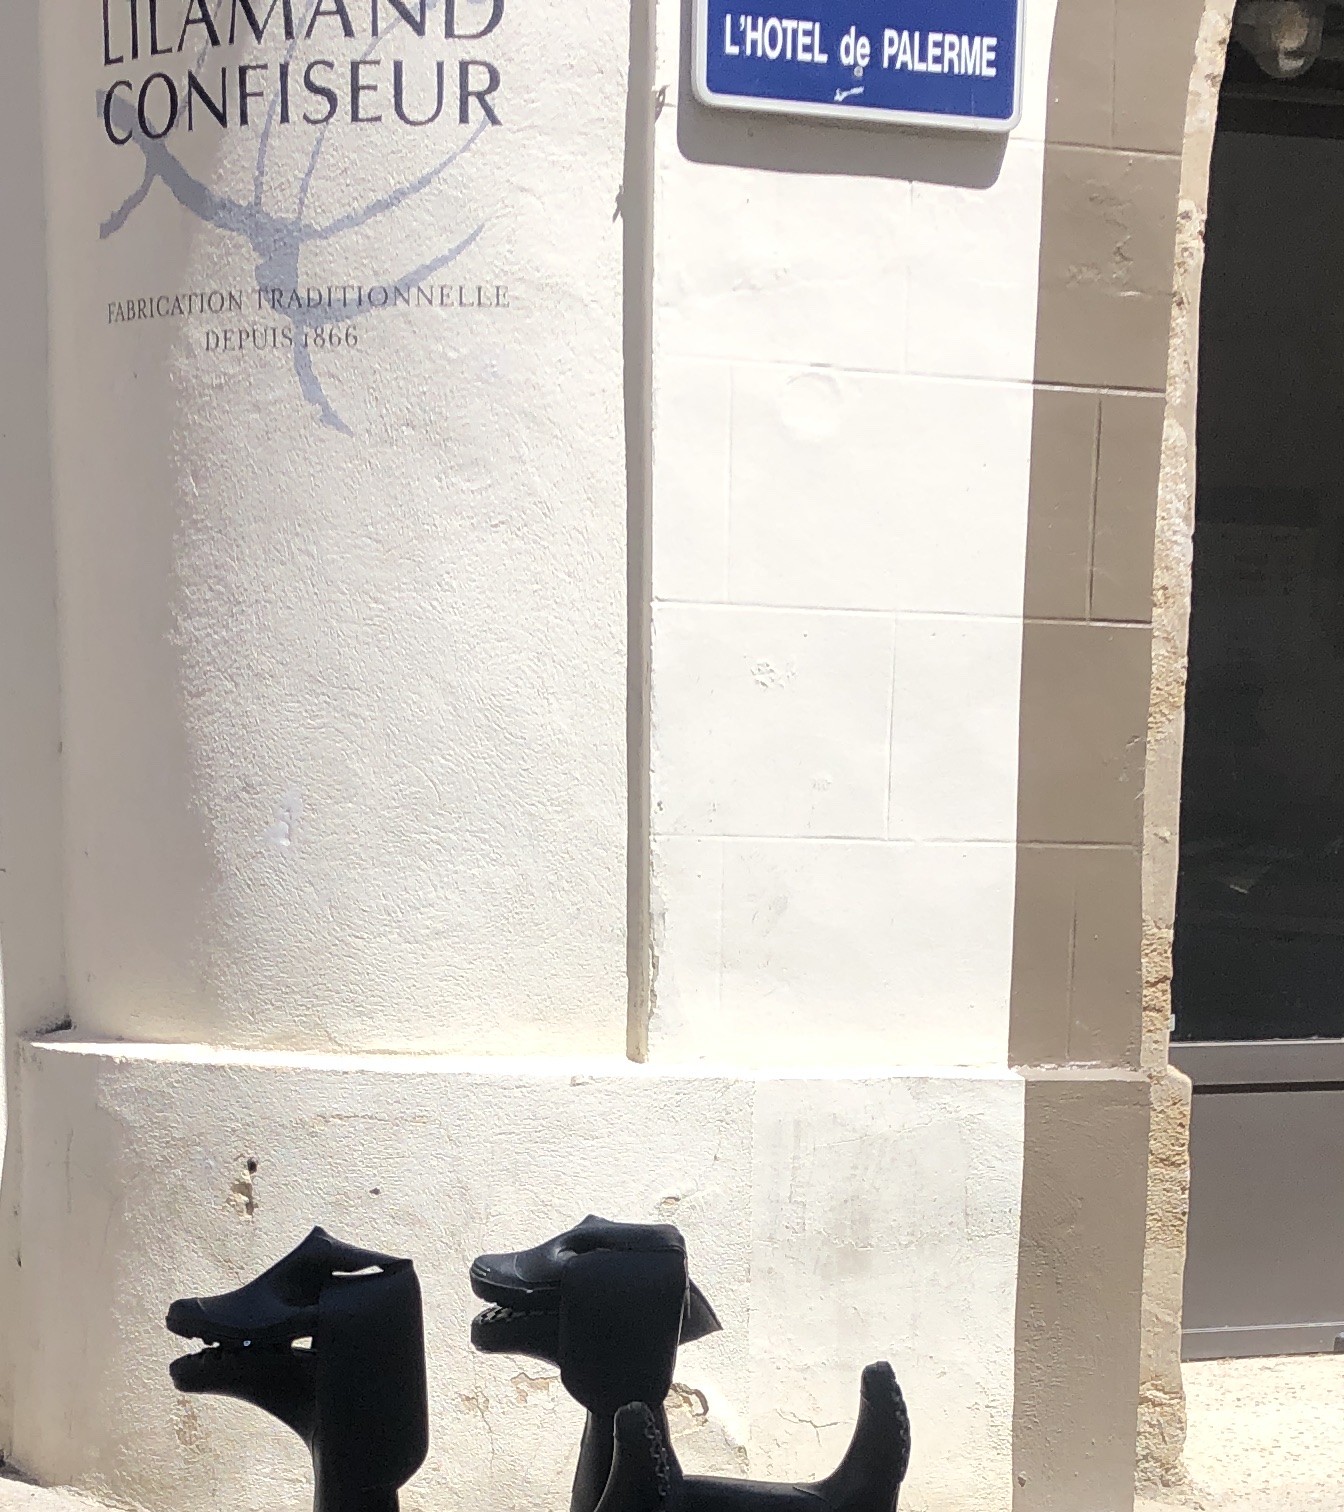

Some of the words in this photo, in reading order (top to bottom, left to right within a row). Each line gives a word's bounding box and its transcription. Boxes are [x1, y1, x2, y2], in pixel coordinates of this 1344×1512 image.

[102, 0, 506, 66] LILAMAND
[723, 13, 828, 64] L'HOTEL
[839, 25, 871, 67] de
[883, 28, 998, 78] PALERME
[102, 59, 504, 146] CONFISEUR
[107, 289, 244, 325] FABRICATION
[256, 284, 511, 312] TRADITIONNELLE
[205, 327, 293, 353] DEPUIS
[301, 325, 359, 350] 1866
